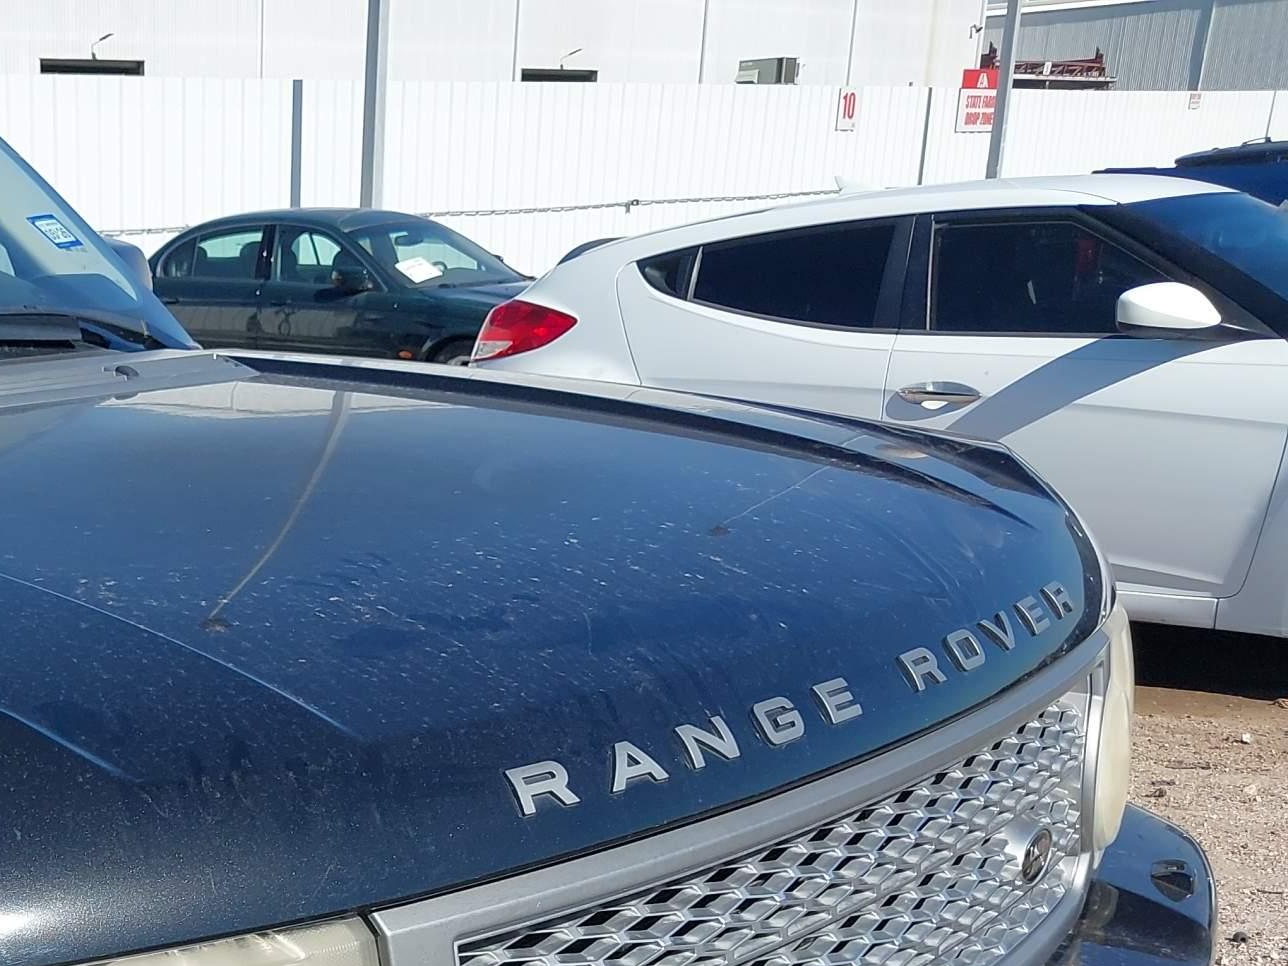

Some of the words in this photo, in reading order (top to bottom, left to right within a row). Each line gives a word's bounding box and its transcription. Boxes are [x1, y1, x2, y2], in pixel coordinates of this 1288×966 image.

[842, 92, 856, 119] 10
[965, 95, 982, 109] STATE
[504, 677, 864, 817] RANGE
[896, 580, 1075, 692] ROVER
